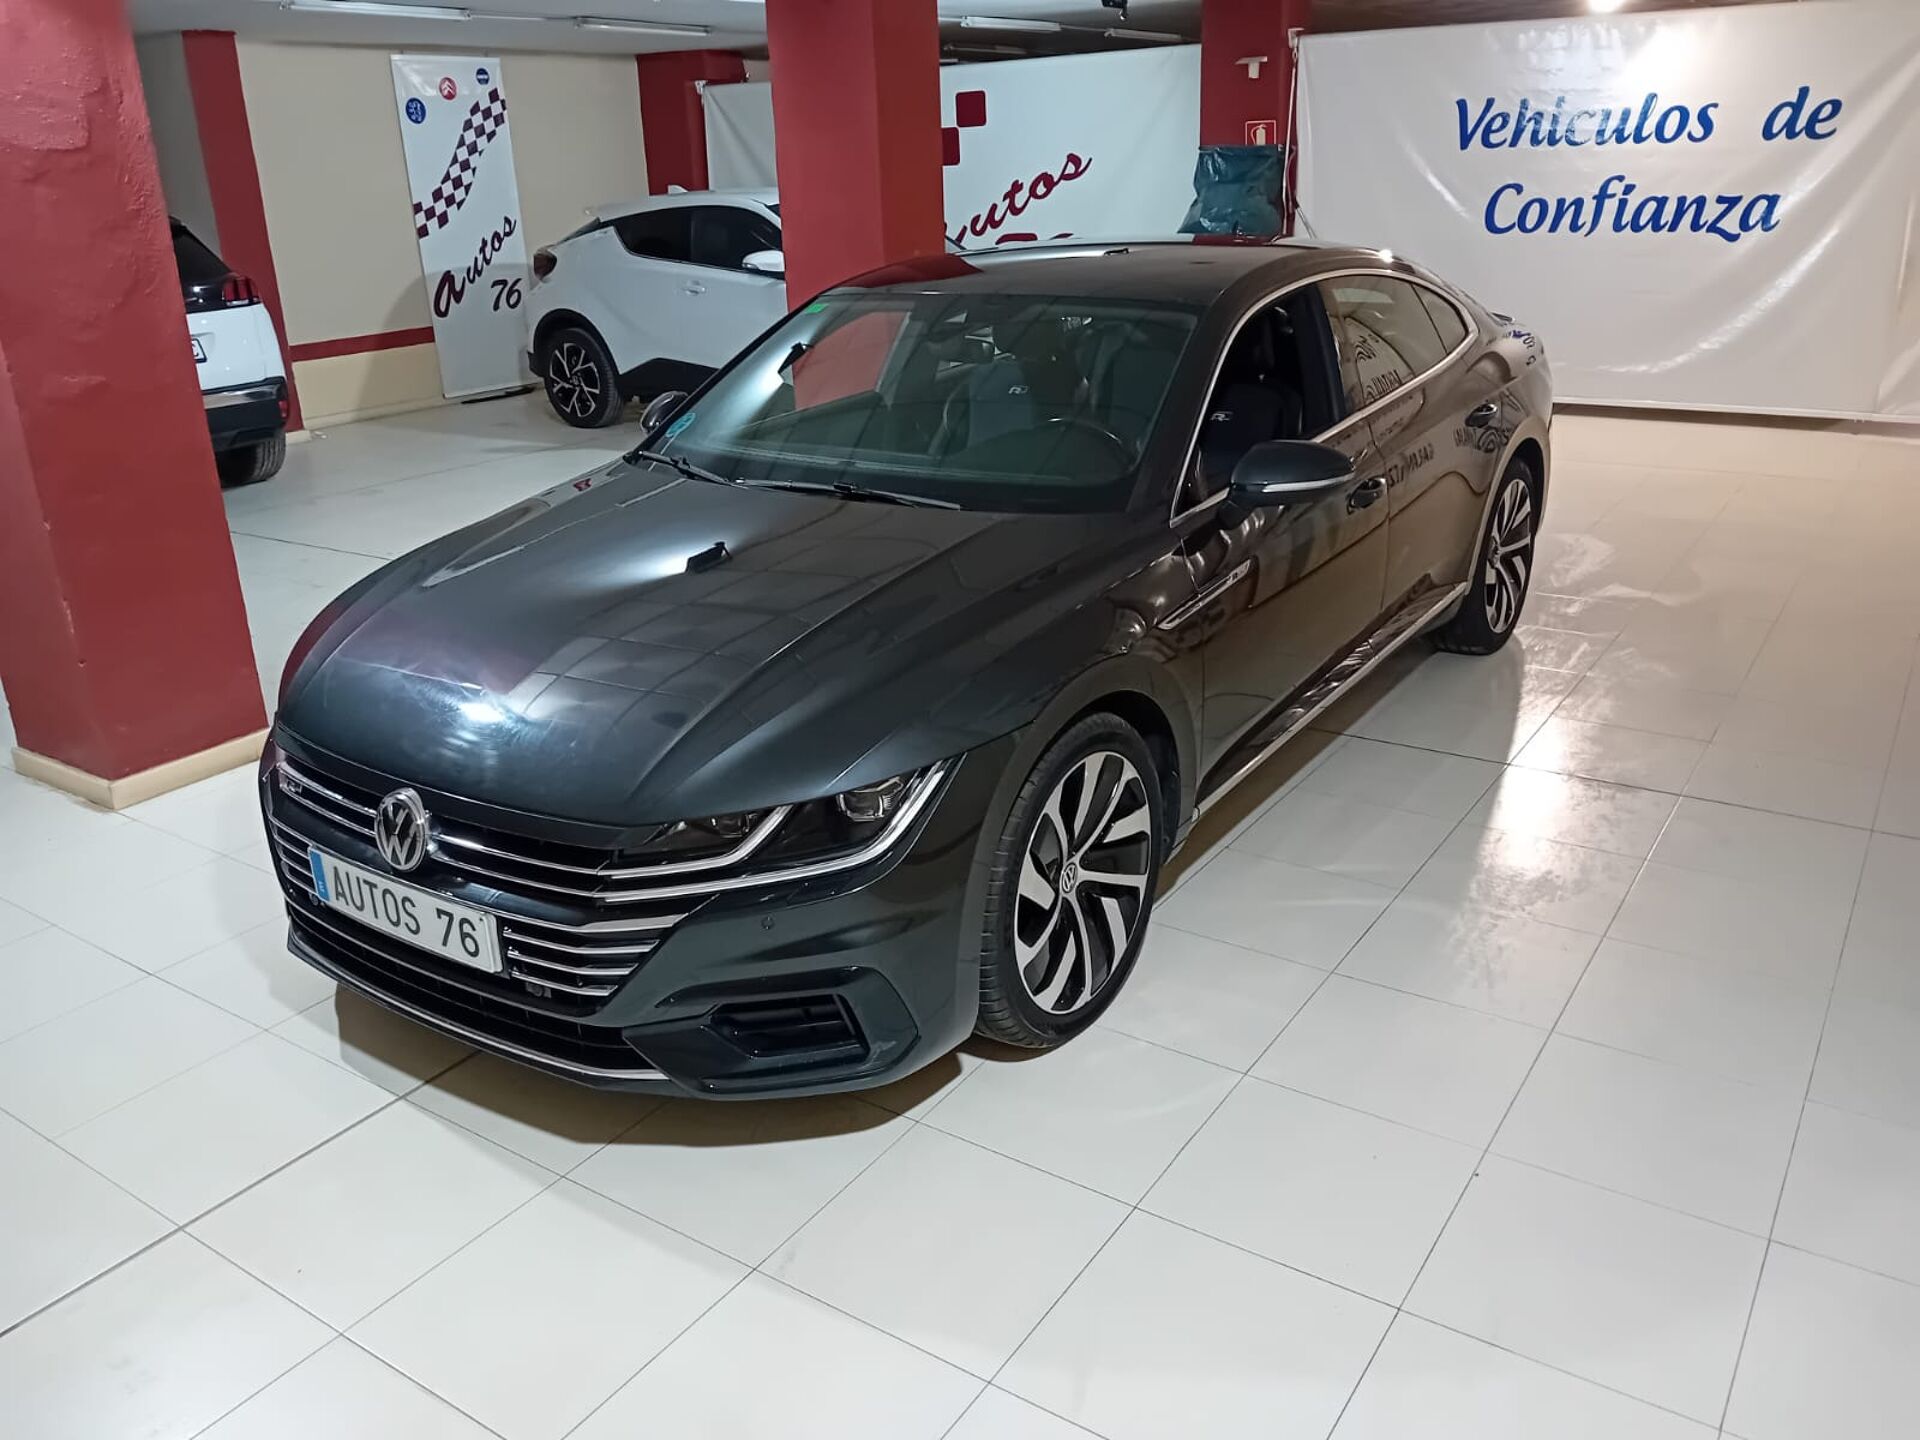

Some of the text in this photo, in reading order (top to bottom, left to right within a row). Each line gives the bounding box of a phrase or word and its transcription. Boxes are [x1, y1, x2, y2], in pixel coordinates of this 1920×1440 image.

[1762, 85, 1842, 140] de
[1484, 174, 1782, 243] Confianza
[491, 278, 522, 312] 76
[333, 866, 480, 958] AUTOS 76
